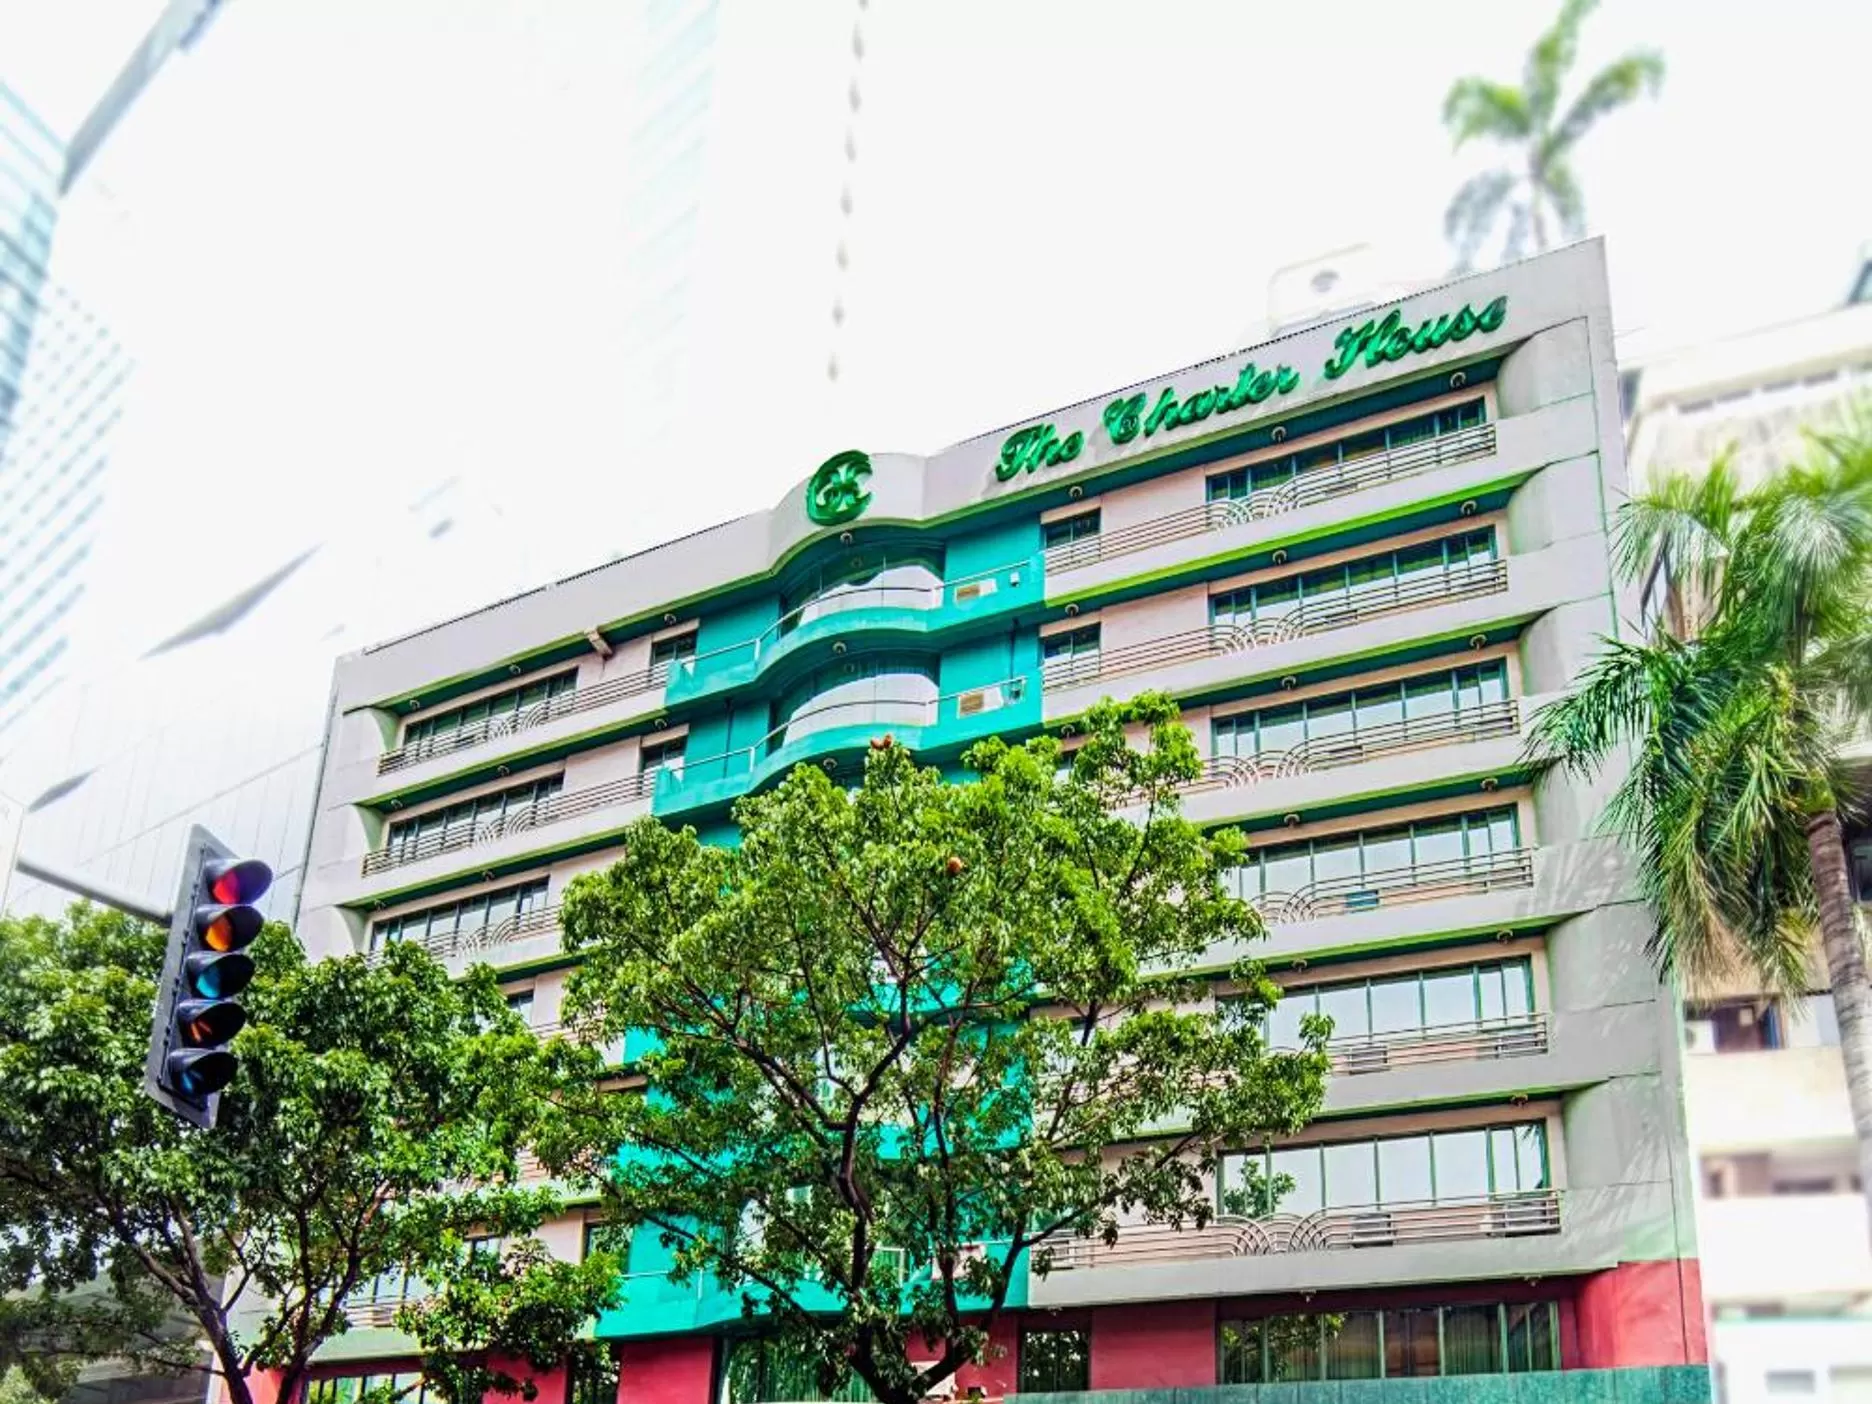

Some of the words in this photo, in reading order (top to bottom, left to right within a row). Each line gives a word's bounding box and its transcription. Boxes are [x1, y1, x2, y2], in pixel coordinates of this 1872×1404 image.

[996, 422, 1085, 482] The
[1103, 362, 1300, 446] Charter
[1324, 295, 1508, 380] House
